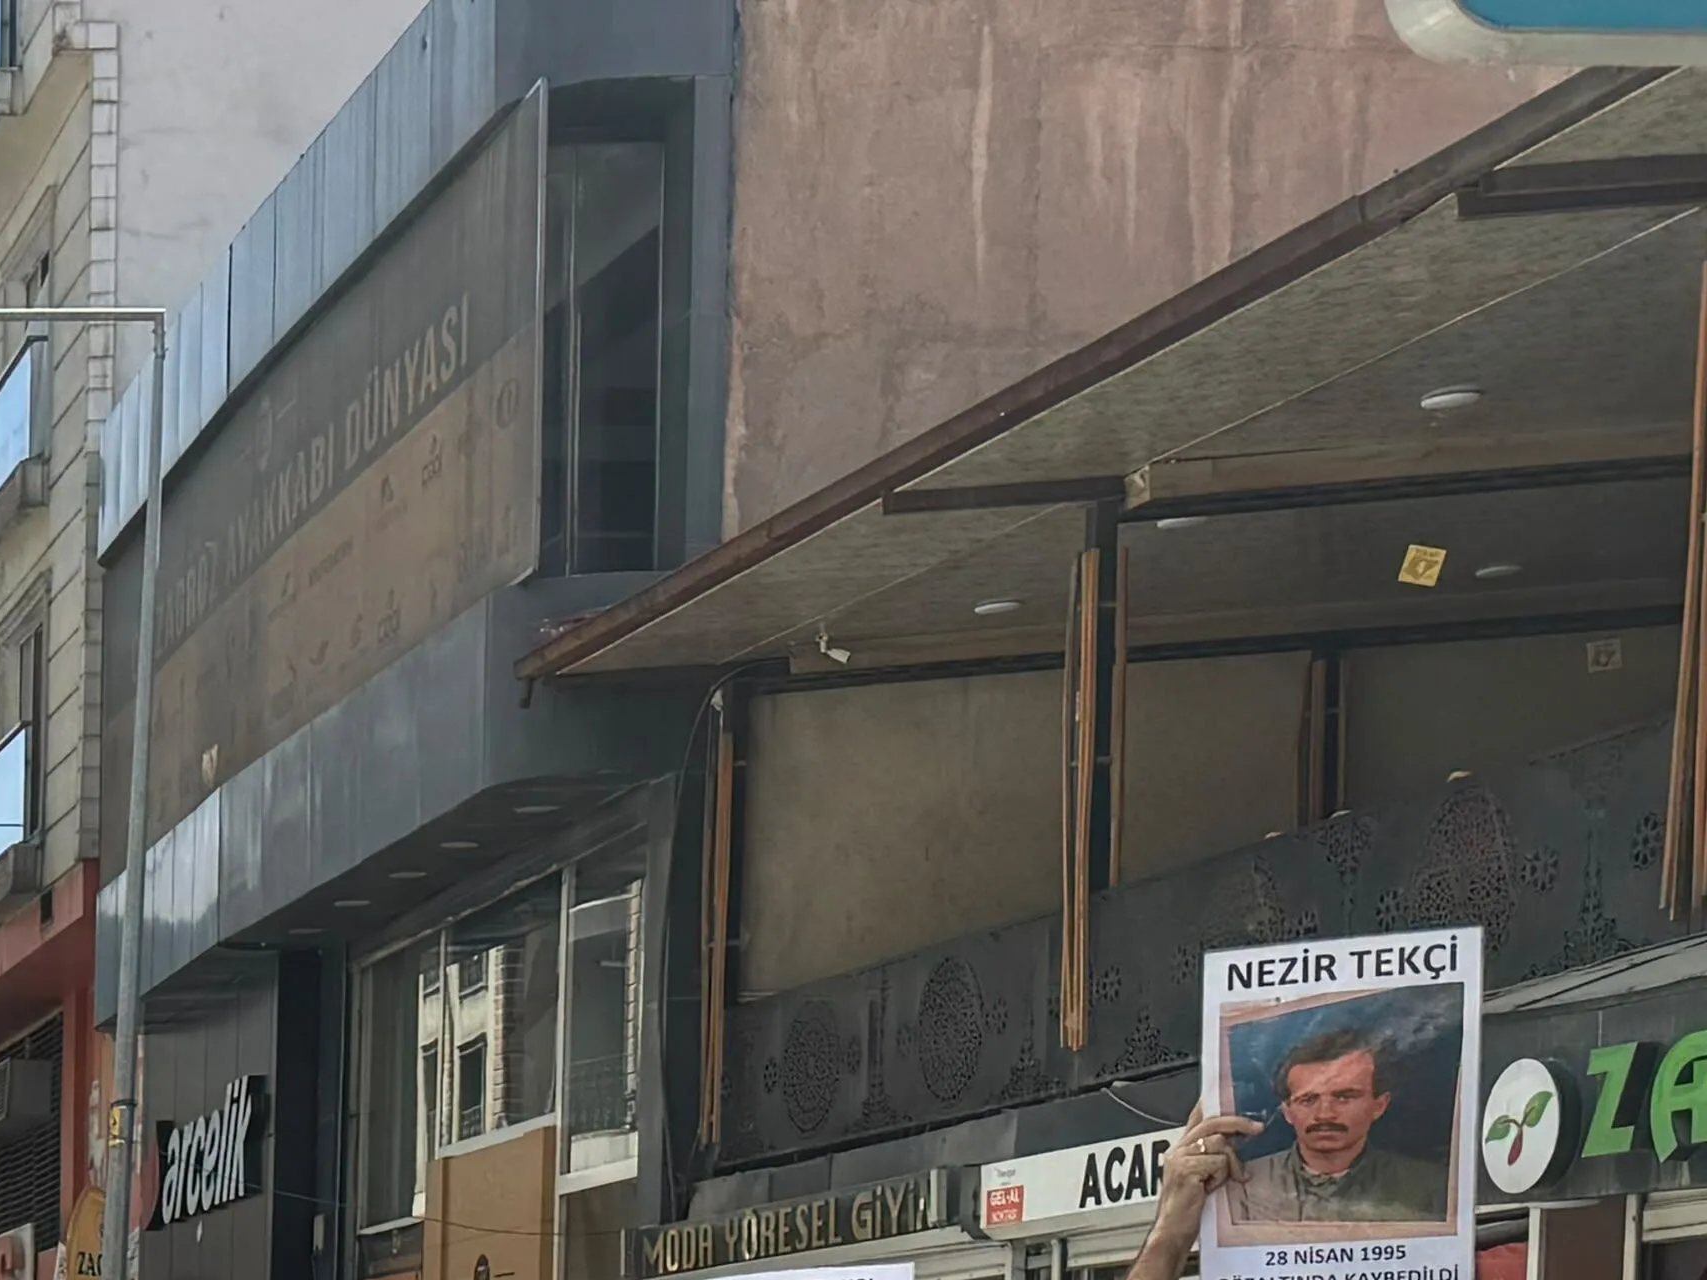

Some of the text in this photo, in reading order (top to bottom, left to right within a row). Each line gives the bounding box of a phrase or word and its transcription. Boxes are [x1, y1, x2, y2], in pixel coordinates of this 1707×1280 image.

[1227, 934, 1459, 992] NEZİR TEKÇİ
[642, 1222, 712, 1276] MODA
[723, 1199, 843, 1262] YÖRESEL
[1264, 1244, 1407, 1267] 28 NİSAN 1995
